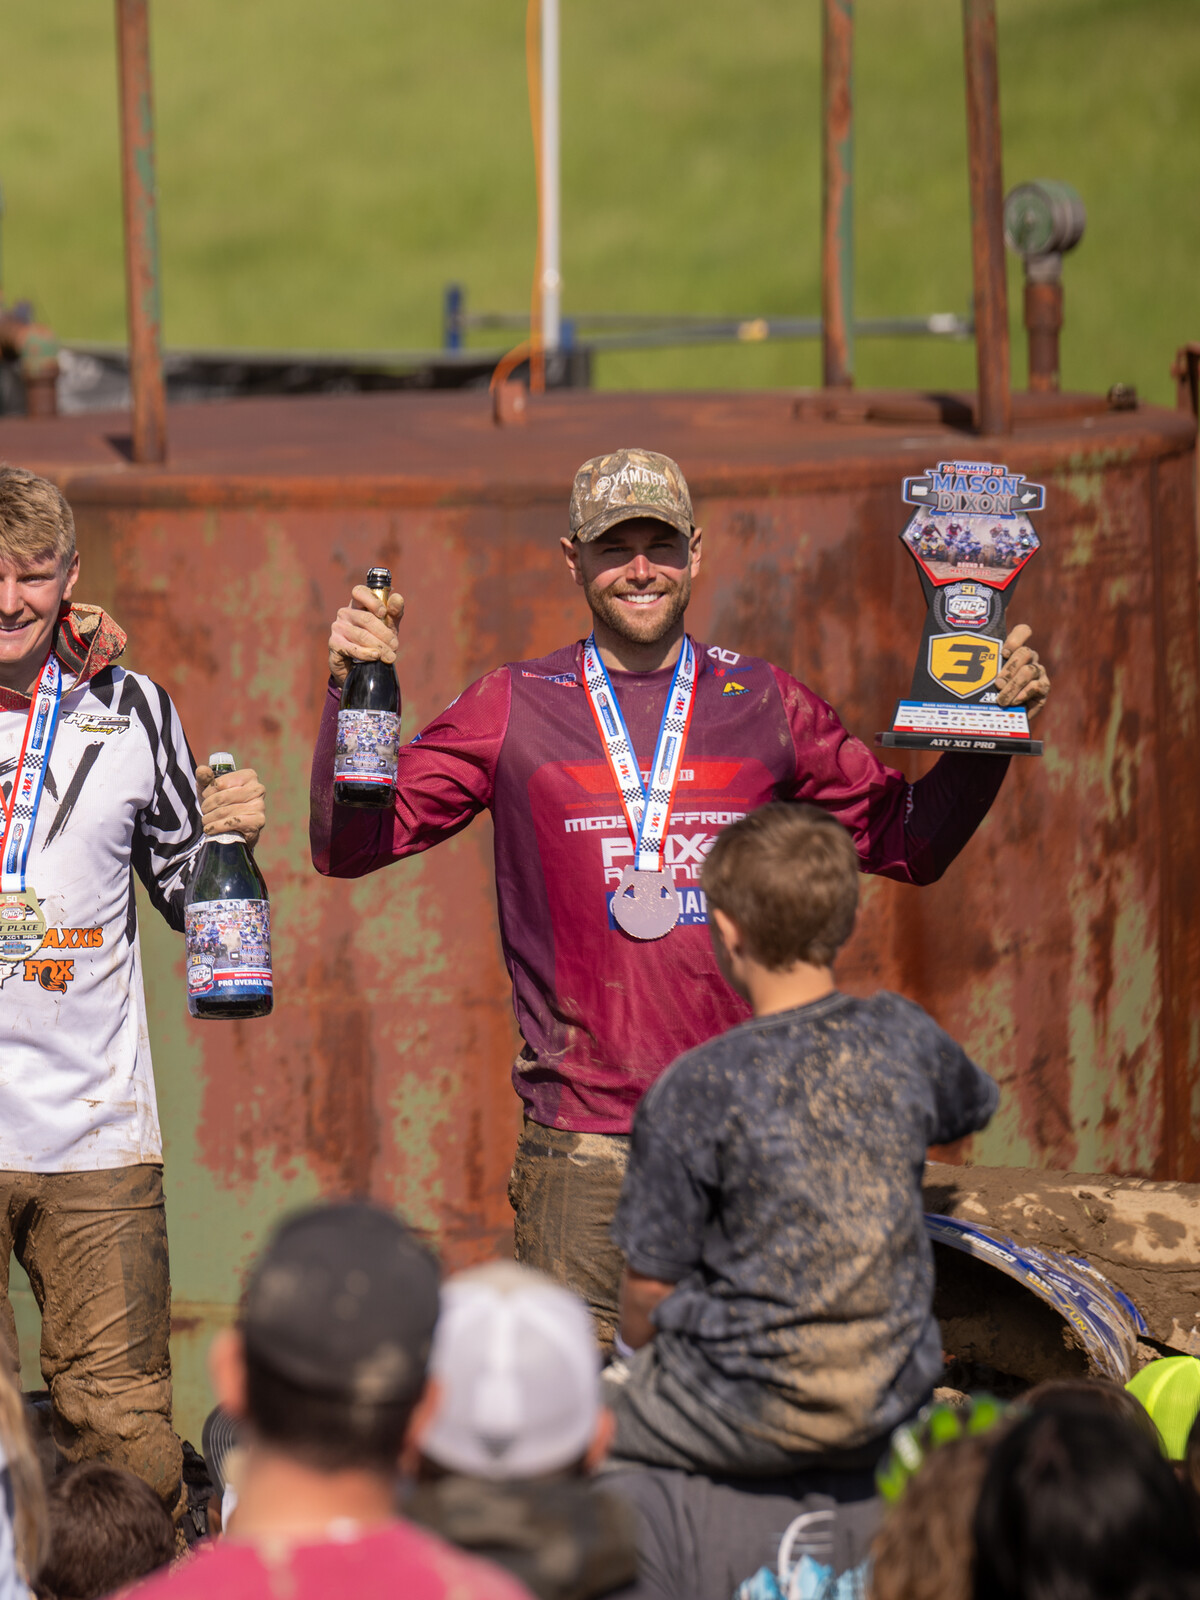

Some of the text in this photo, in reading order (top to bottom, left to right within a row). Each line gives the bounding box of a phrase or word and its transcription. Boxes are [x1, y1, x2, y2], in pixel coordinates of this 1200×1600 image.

[610, 469, 669, 488] YAMAHA
[931, 473, 1020, 497] MASON
[936, 492, 1013, 516] DIXON
[930, 739, 952, 747] ATV
[973, 741, 996, 750] PRO
[21, 772, 36, 801] AMA
[6, 924, 39, 932] PLACE
[40, 927, 104, 950] AXXIS
[23, 959, 75, 988] FOX
